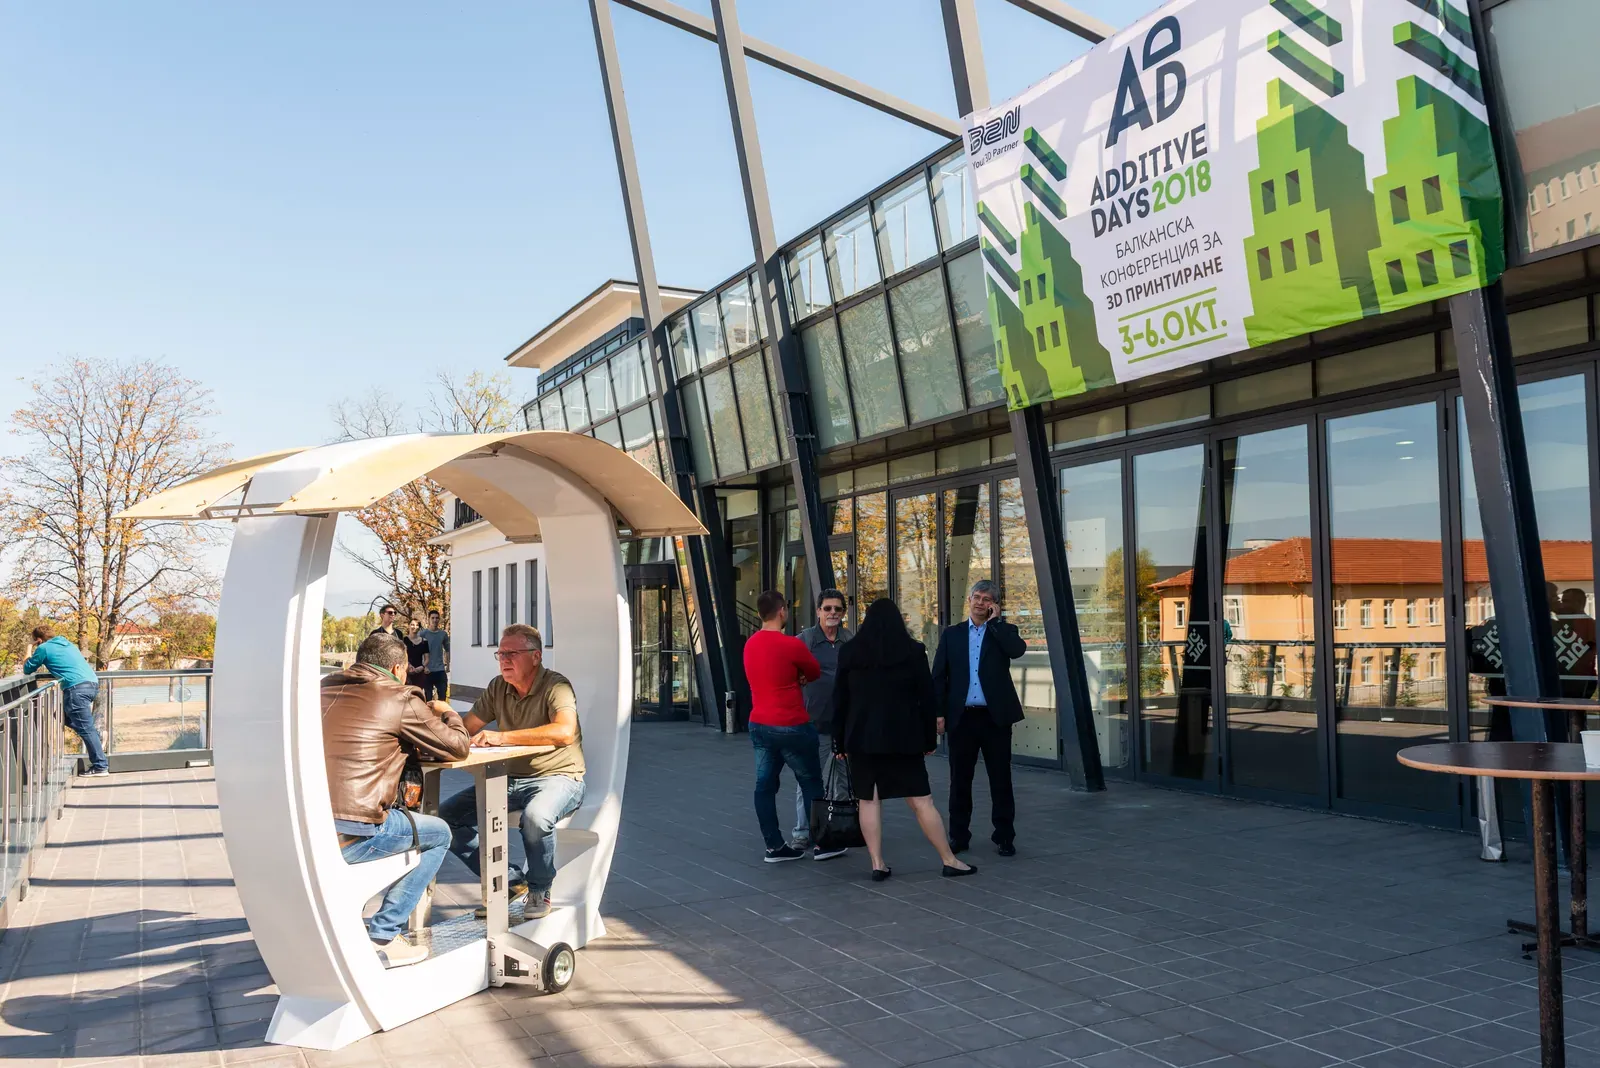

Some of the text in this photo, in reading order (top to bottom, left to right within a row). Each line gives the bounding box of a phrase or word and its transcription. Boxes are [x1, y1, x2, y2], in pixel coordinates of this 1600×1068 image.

[992, 140, 1019, 157] Partner
[1090, 123, 1208, 206] ADDITIVE
[1091, 160, 1212, 238] DAYS 2018
[1100, 231, 1223, 288] КОНФЕРЕНЦИЯ ЗА
[1115, 215, 1195, 259] БАЛКАНСКА
[1106, 256, 1224, 310] 3D ПРИНТИРАНЕ
[1118, 298, 1228, 355] 3-6.ОКТ.
